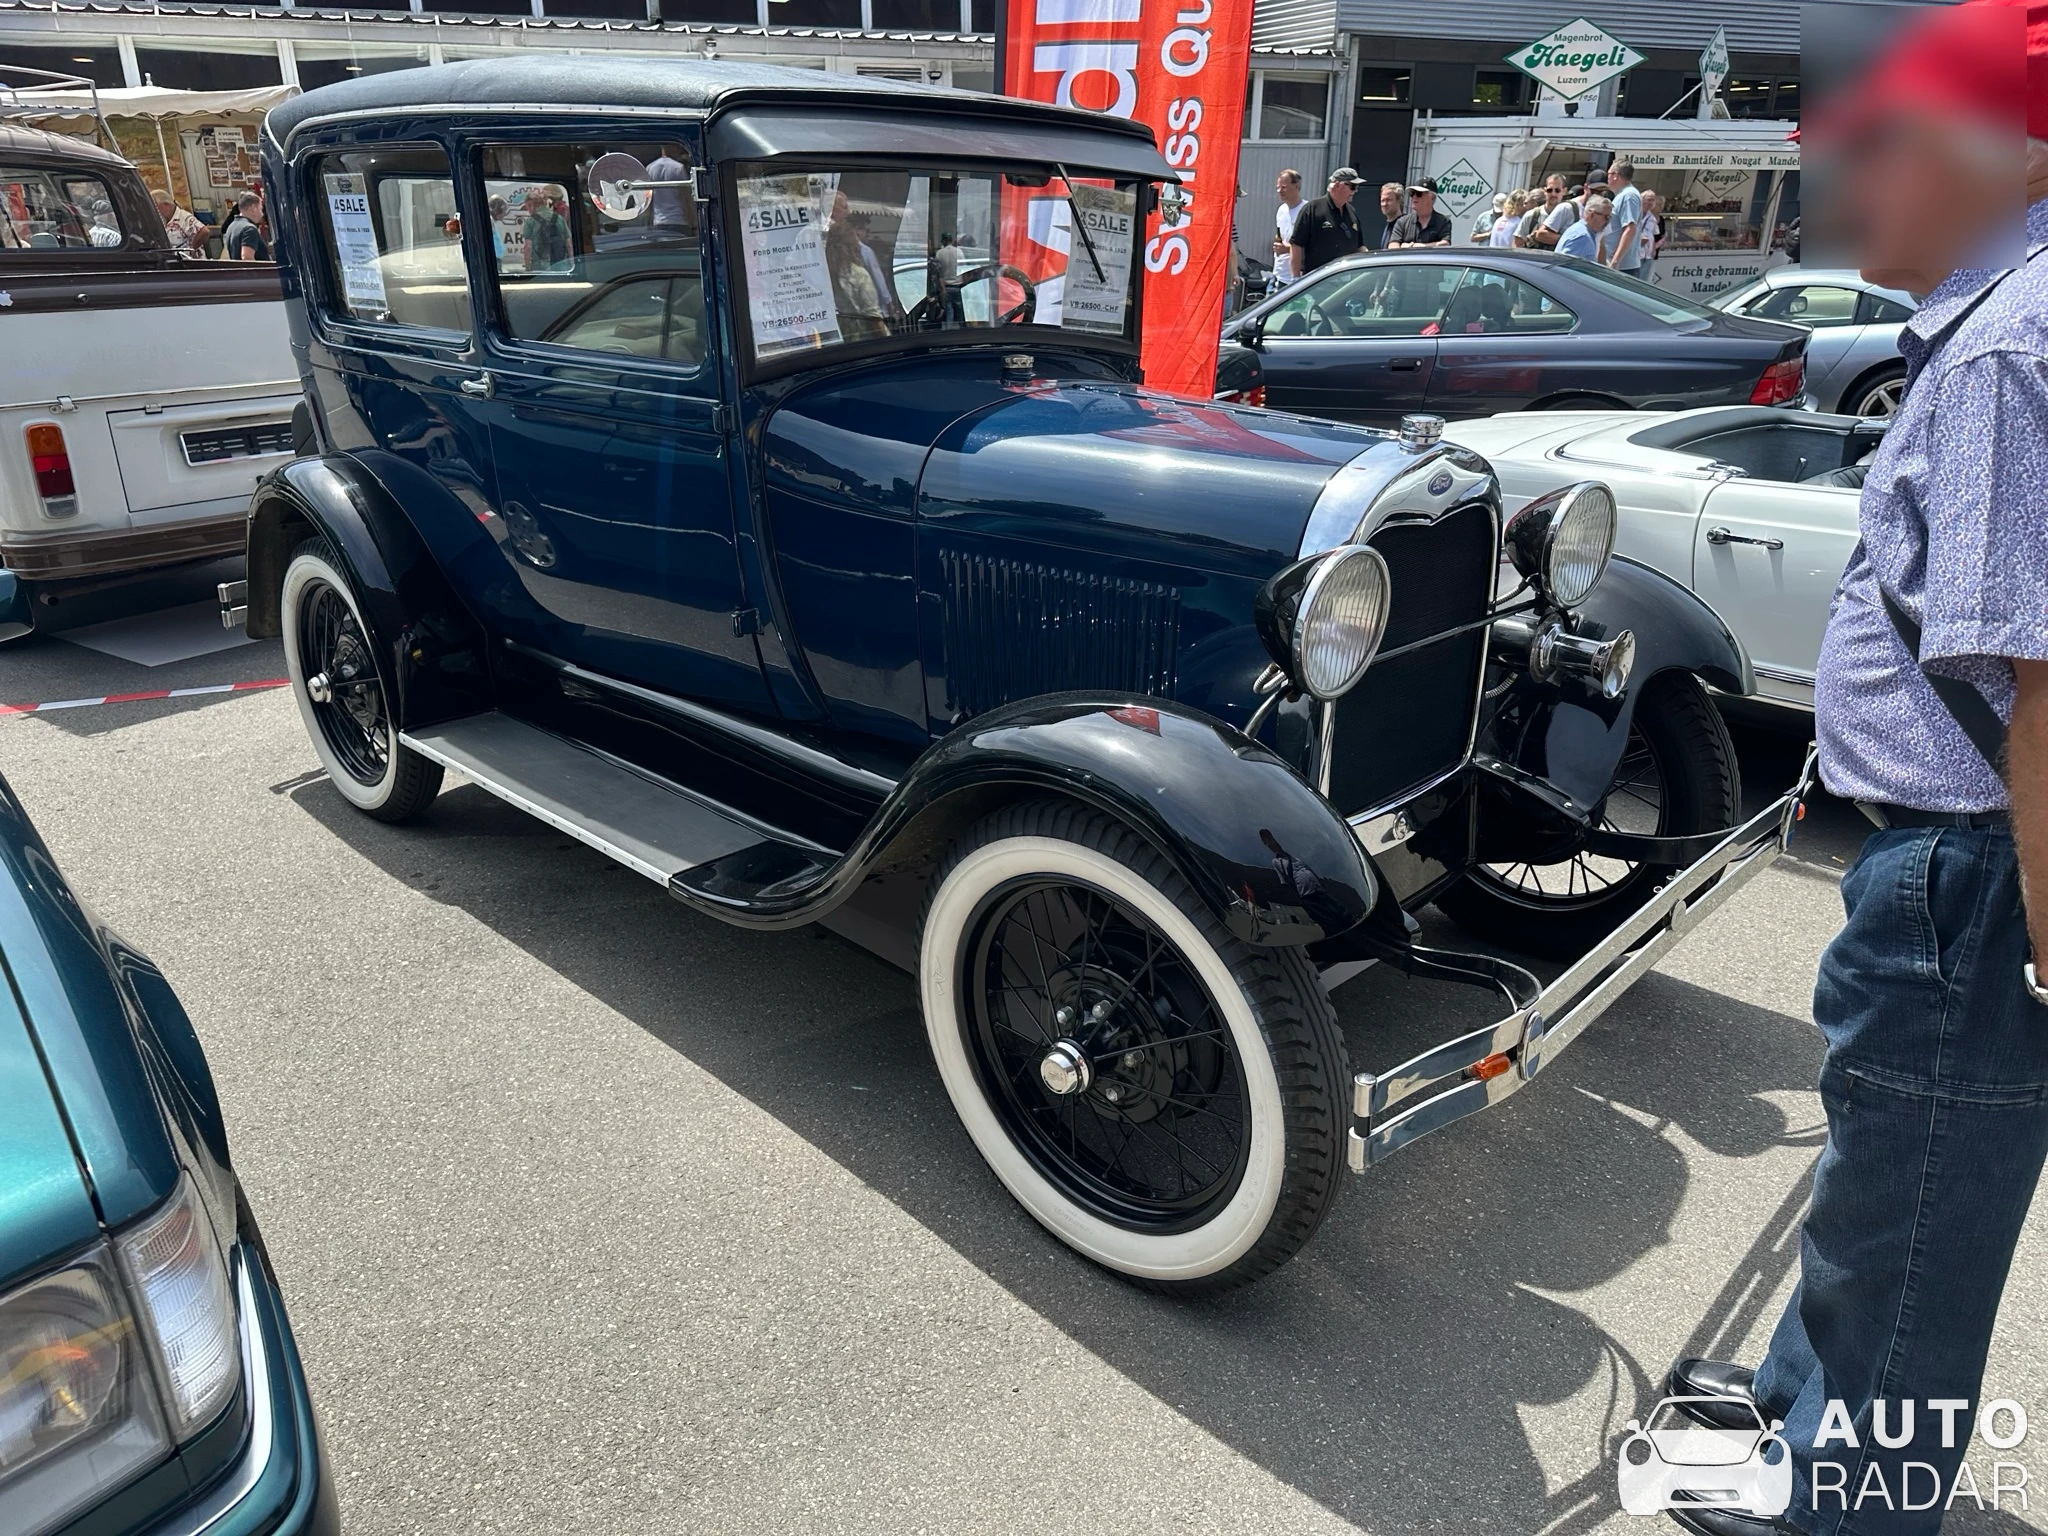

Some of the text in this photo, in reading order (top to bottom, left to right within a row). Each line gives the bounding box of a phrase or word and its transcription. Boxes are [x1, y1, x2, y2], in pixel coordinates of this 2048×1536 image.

[1553, 34, 1603, 43] Magenbrot
[1524, 43, 1626, 72] Haegeli
[1557, 76, 1588, 84] Luzern
[1625, 154, 1665, 165] Mandeln
[1672, 154, 1723, 165] Rahmtäfeli
[1730, 155, 1761, 167] Nougat
[1703, 170, 1741, 185] Haegeli
[1437, 176, 1484, 199] Haegeli
[334, 198, 366, 212] 4SALE
[748, 206, 810, 229] 4SALE
[1672, 265, 1759, 278] frisch gebrannte
[1691, 281, 1732, 293] Mande
